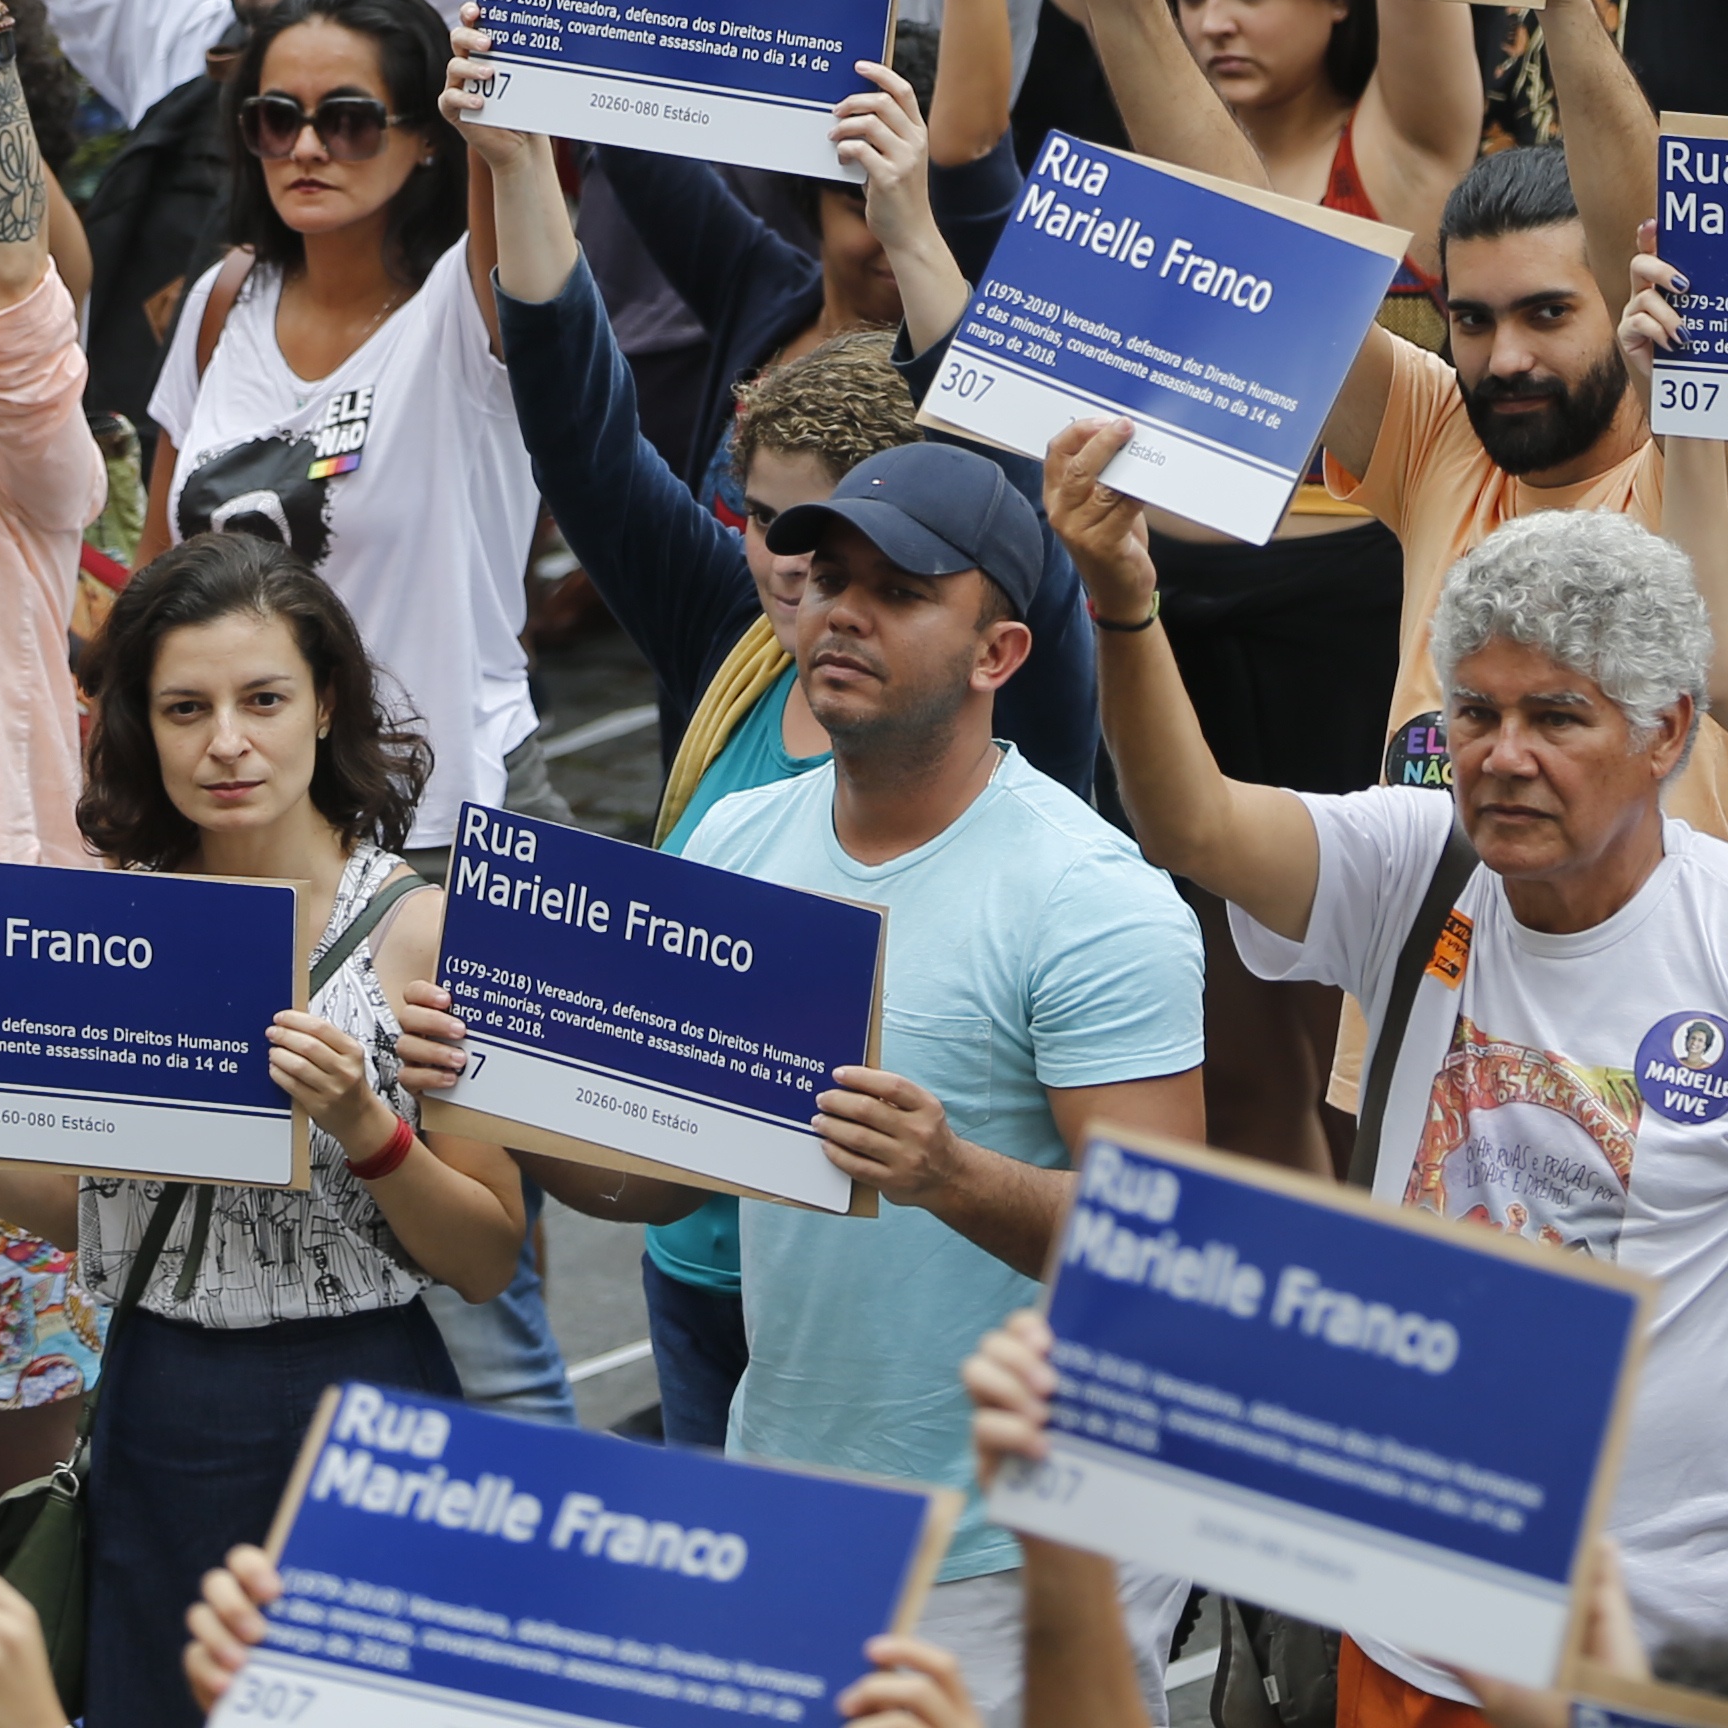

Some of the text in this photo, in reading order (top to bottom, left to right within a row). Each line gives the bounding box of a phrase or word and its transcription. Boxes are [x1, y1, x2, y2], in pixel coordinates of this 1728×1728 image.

[1038, 137, 1108, 196] Rua
[1017, 184, 1272, 312] Marielle Franco
[325, 387, 373, 427] ELE
[1407, 726, 1445, 754] EL
[463, 799, 536, 863] Rua
[6, 918, 152, 969] Franco
[456, 856, 752, 972] Marielle Franco
[1664, 1090, 1709, 1117] VIVE
[334, 1382, 451, 1459] Rua
[310, 1444, 748, 1583] Marielle Franco
